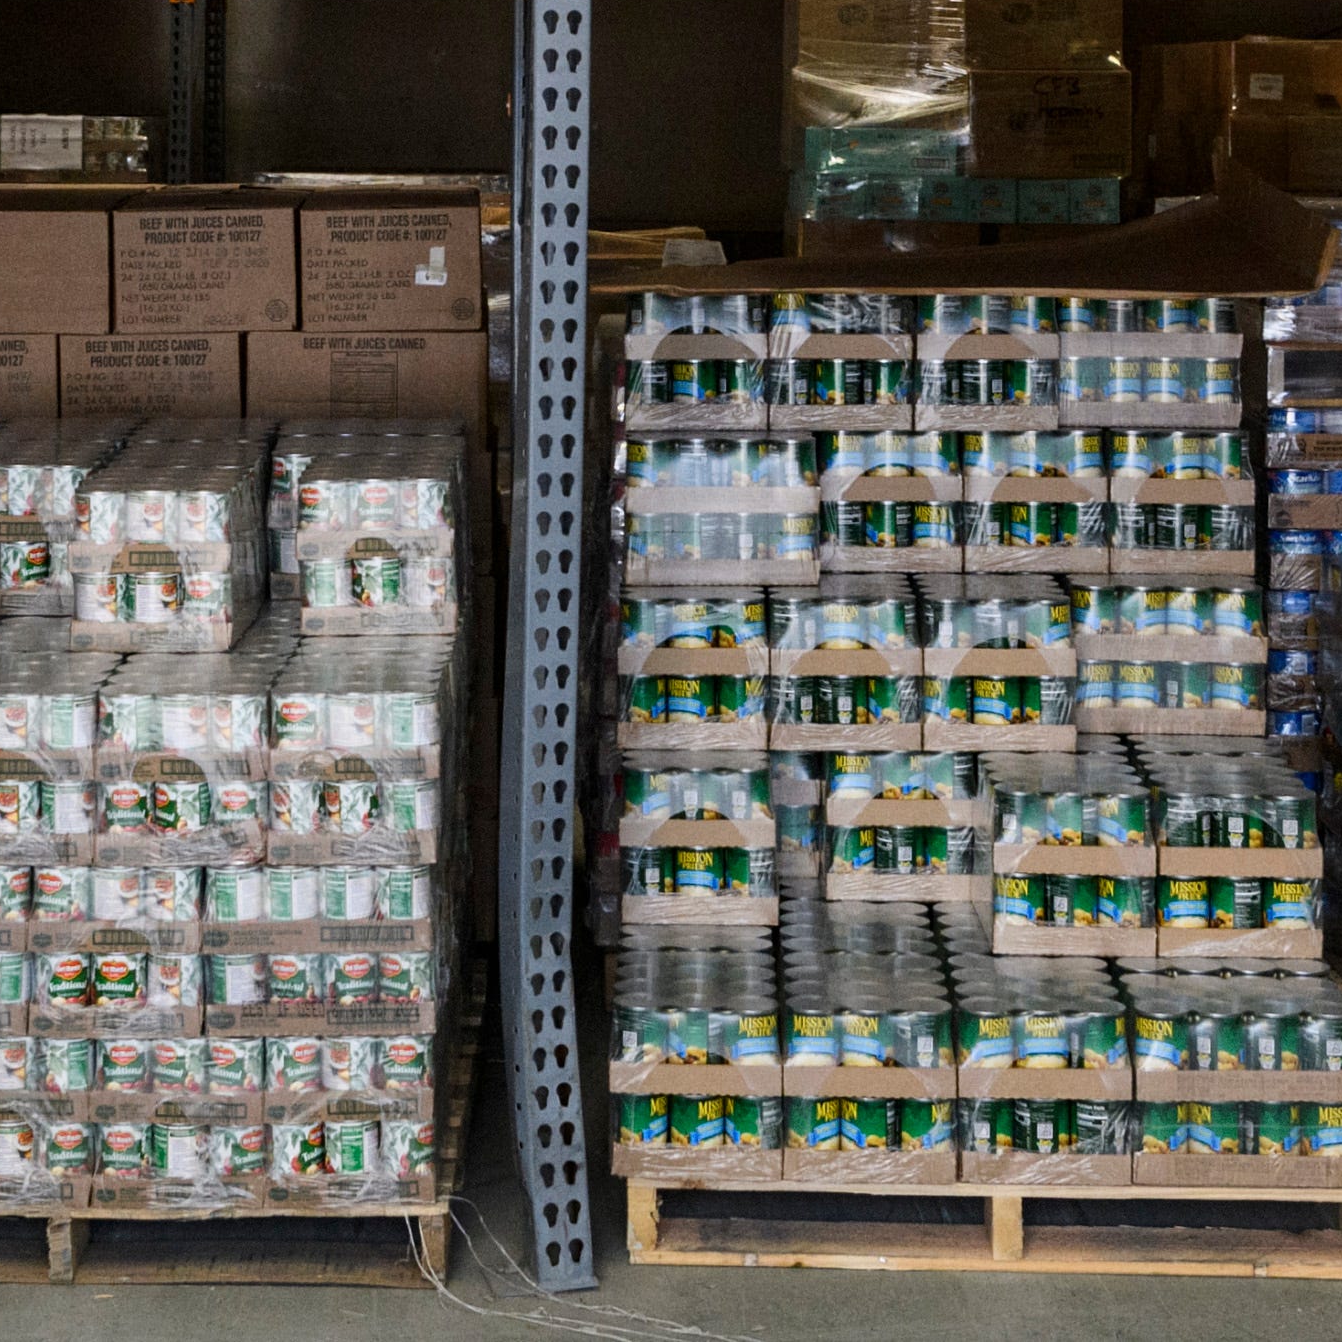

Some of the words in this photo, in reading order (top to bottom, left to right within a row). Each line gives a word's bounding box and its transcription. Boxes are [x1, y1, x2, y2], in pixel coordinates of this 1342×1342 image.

[140, 216, 163, 229] BEEF
[165, 216, 188, 229] WITH
[191, 216, 224, 229] JUICES
[326, 215, 349, 228] BEEF
[351, 215, 375, 228] WITH
[378, 215, 409, 228] JUICES
[145, 231, 187, 243] PRODUCT
[190, 231, 214, 243] CODE
[229, 231, 261, 243] 100127
[331, 230, 374, 242] PRODUCT
[376, 230, 402, 242] CODE
[415, 230, 447, 242] 100127
[85, 340, 108, 353] BEEF
[111, 340, 135, 353] WITH
[137, 340, 169, 353] JUICES
[303, 338, 325, 349] BEEF
[329, 338, 353, 349] WITH
[355, 338, 386, 349] JUICES
[389, 338, 426, 349] CANNED
[90, 354, 133, 367] PRODUCT
[136, 354, 160, 367] CODE
[174, 354, 207, 367] 100127
